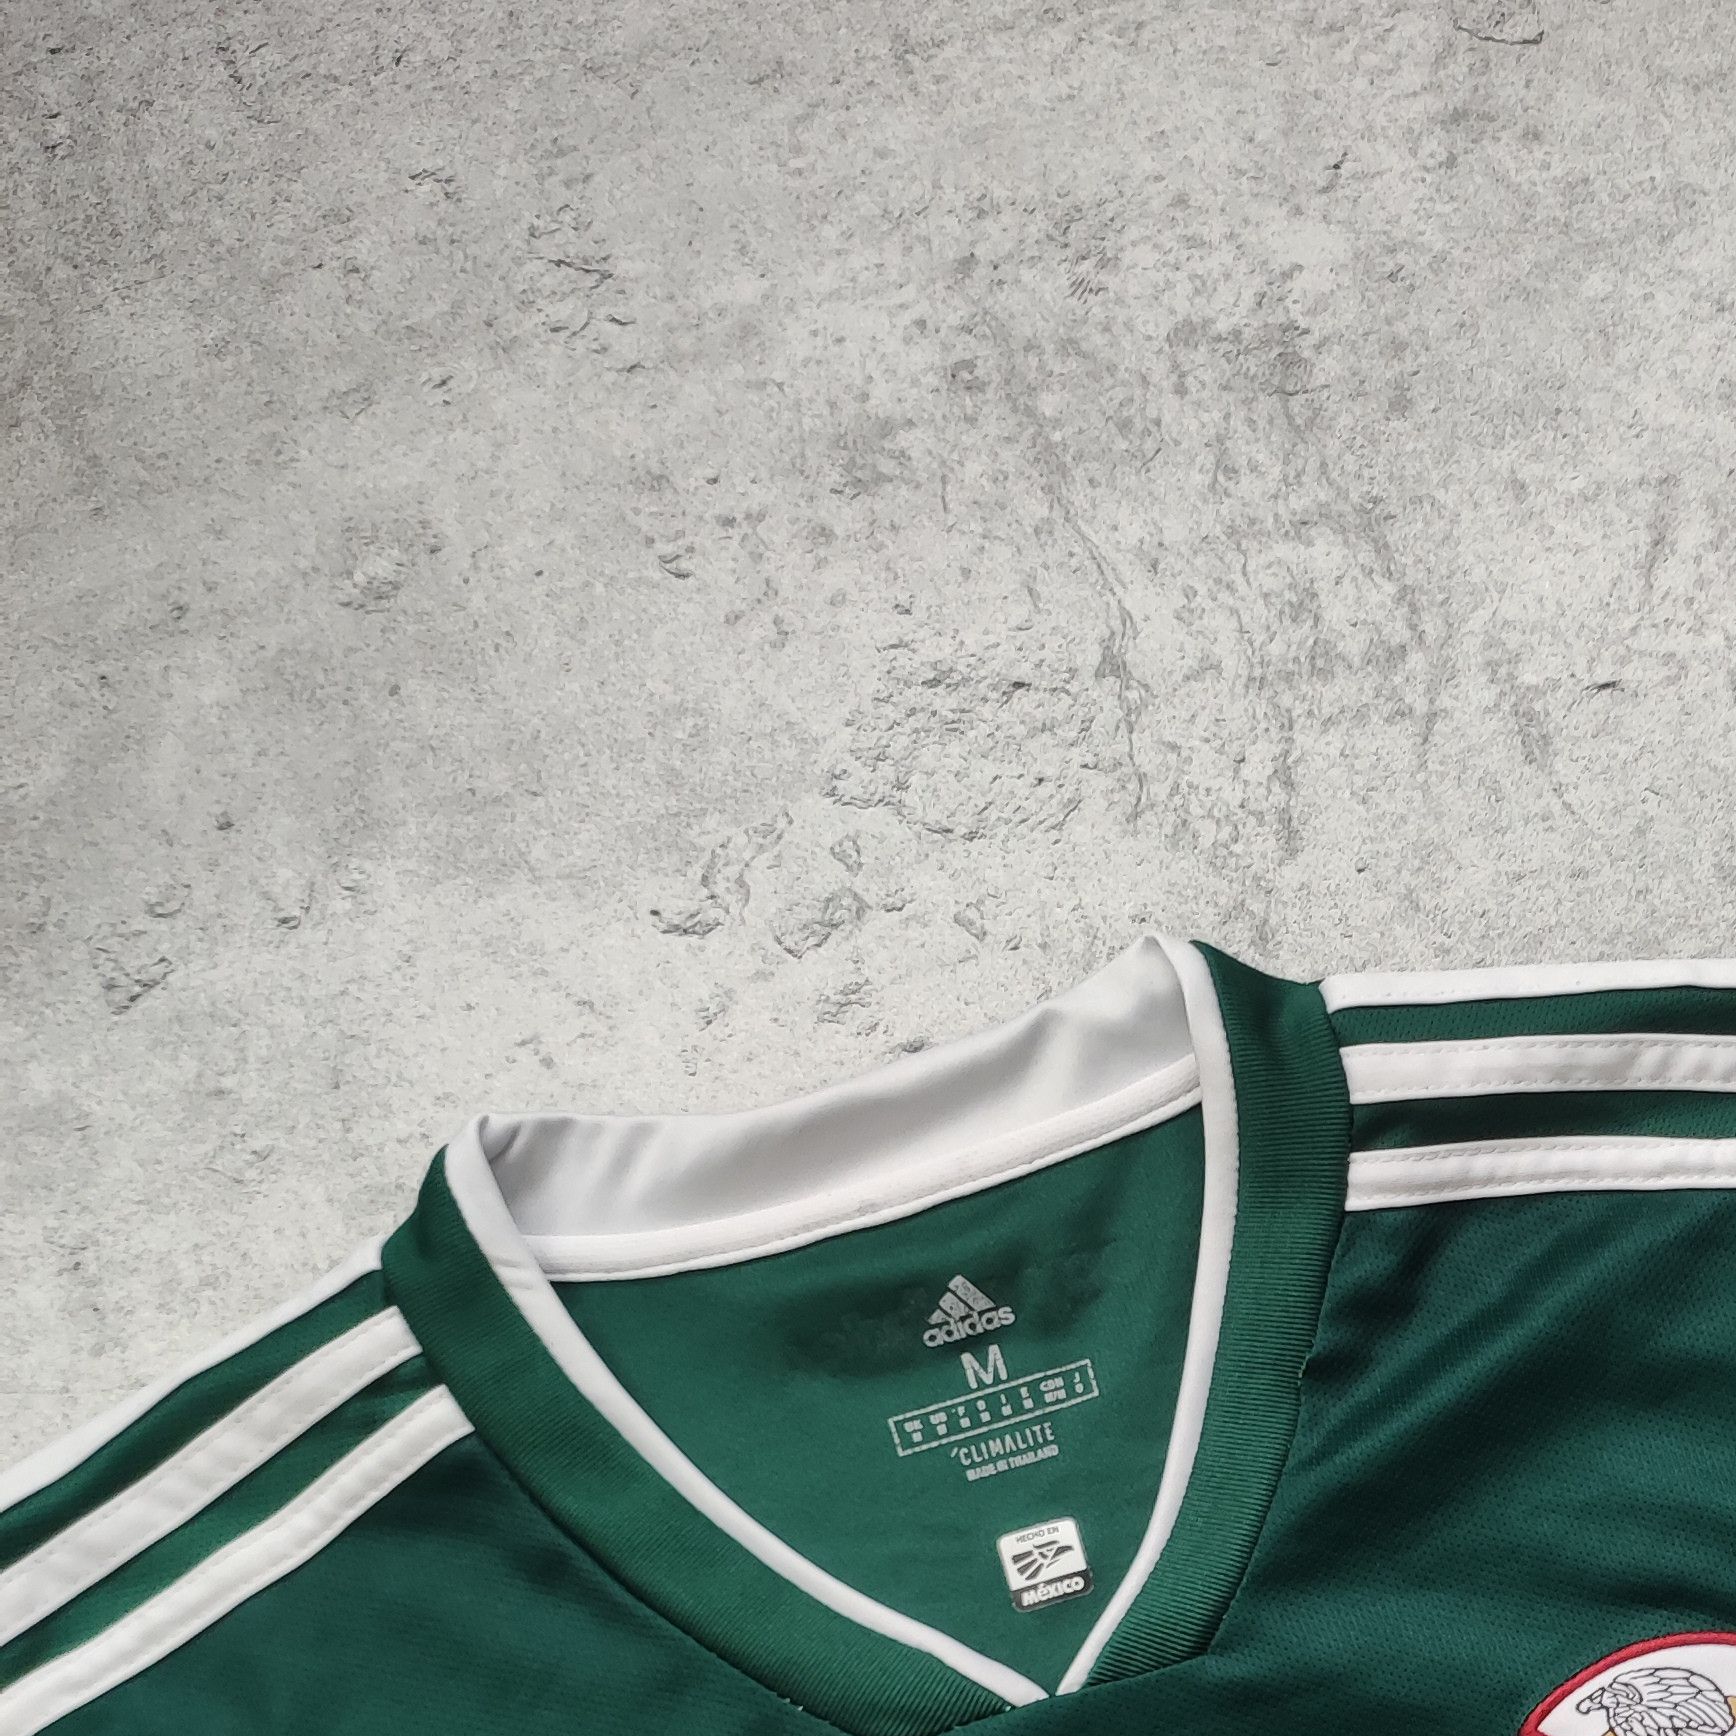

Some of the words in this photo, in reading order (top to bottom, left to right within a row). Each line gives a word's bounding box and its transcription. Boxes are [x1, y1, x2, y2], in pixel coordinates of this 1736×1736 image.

[923, 1306, 1016, 1348] adidas
[961, 1344, 1008, 1389] M
[959, 1422, 1055, 1466] CLIMALITE
